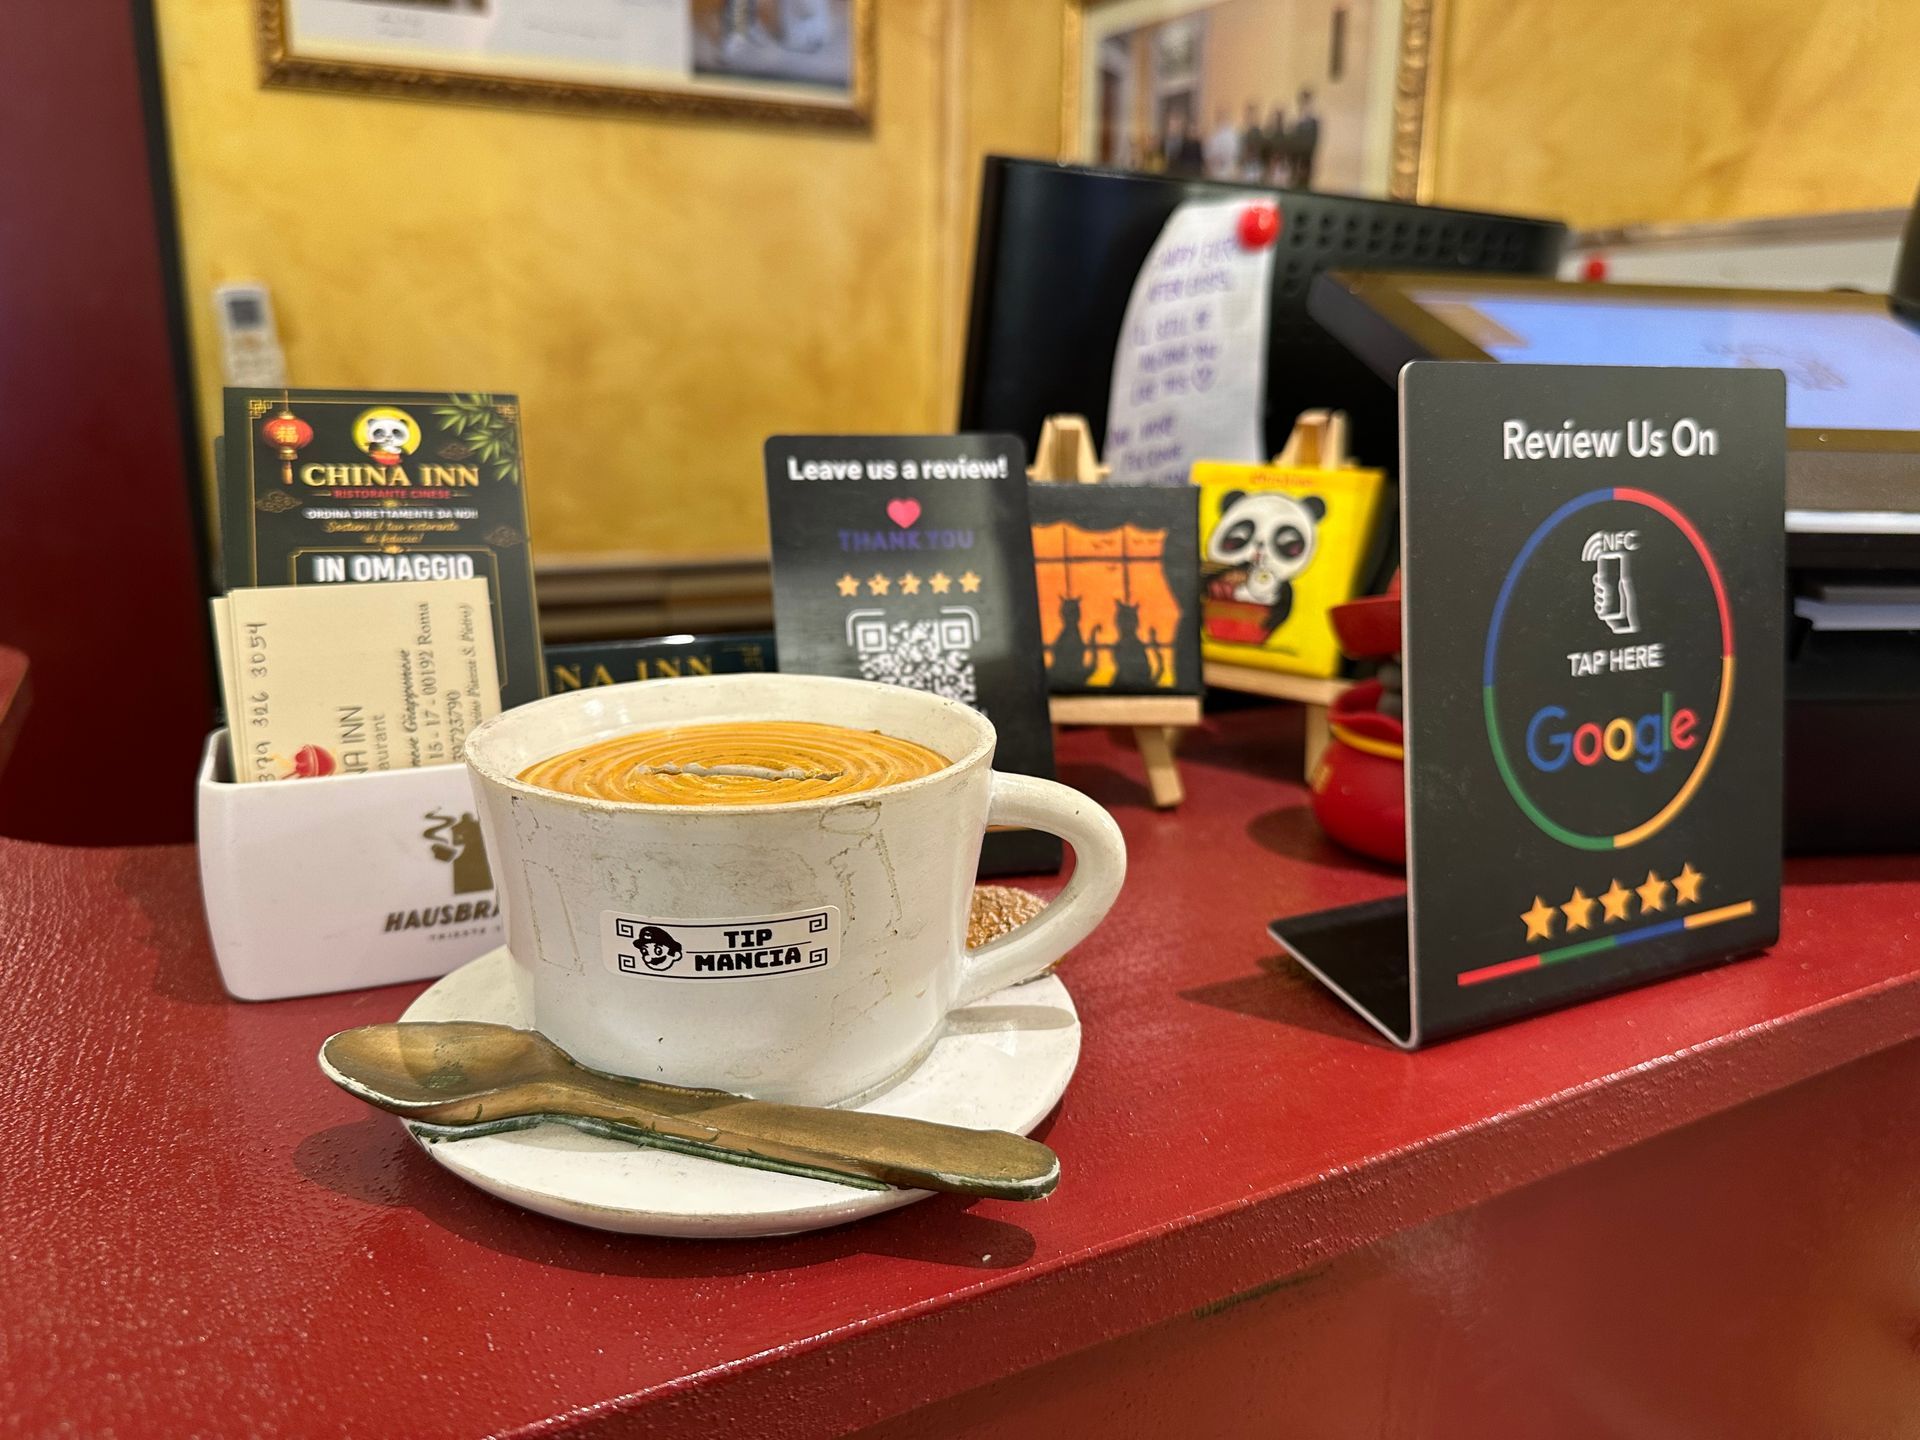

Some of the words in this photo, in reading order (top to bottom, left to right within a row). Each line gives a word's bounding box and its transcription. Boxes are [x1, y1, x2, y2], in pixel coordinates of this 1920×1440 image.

[1503, 419, 1621, 460] Review
[1627, 419, 1667, 457] Us
[1671, 418, 1719, 457] On
[302, 463, 411, 487] CHINA
[420, 463, 480, 487] INN
[787, 456, 862, 480] Leave
[867, 461, 898, 480] us
[902, 460, 918, 479] a
[922, 455, 1008, 479] review!
[333, 488, 407, 499] RISTORANTE
[411, 488, 451, 499] CINESE
[305, 508, 351, 519] ORDINA
[352, 508, 434, 519] DIRETTAMENTE
[437, 508, 452, 519] DA
[838, 530, 921, 550] THANK
[926, 530, 975, 550] YOU
[1603, 530, 1640, 551] NFC
[313, 555, 345, 582] IN
[350, 553, 475, 582] OMAGGIO
[417, 602, 433, 646] Roma
[247, 623, 268, 677] 3054
[1567, 650, 1609, 677] TAP
[1610, 643, 1665, 672] HERE
[418, 650, 438, 696] 00192
[636, 655, 712, 682] INN
[252, 691, 269, 727] 326
[424, 709, 441, 727] 17
[338, 706, 366, 744] INN
[1525, 691, 1697, 773] Google
[429, 741, 444, 759] 15
[724, 929, 772, 948] TIP
[695, 947, 801, 972] MANCIA
